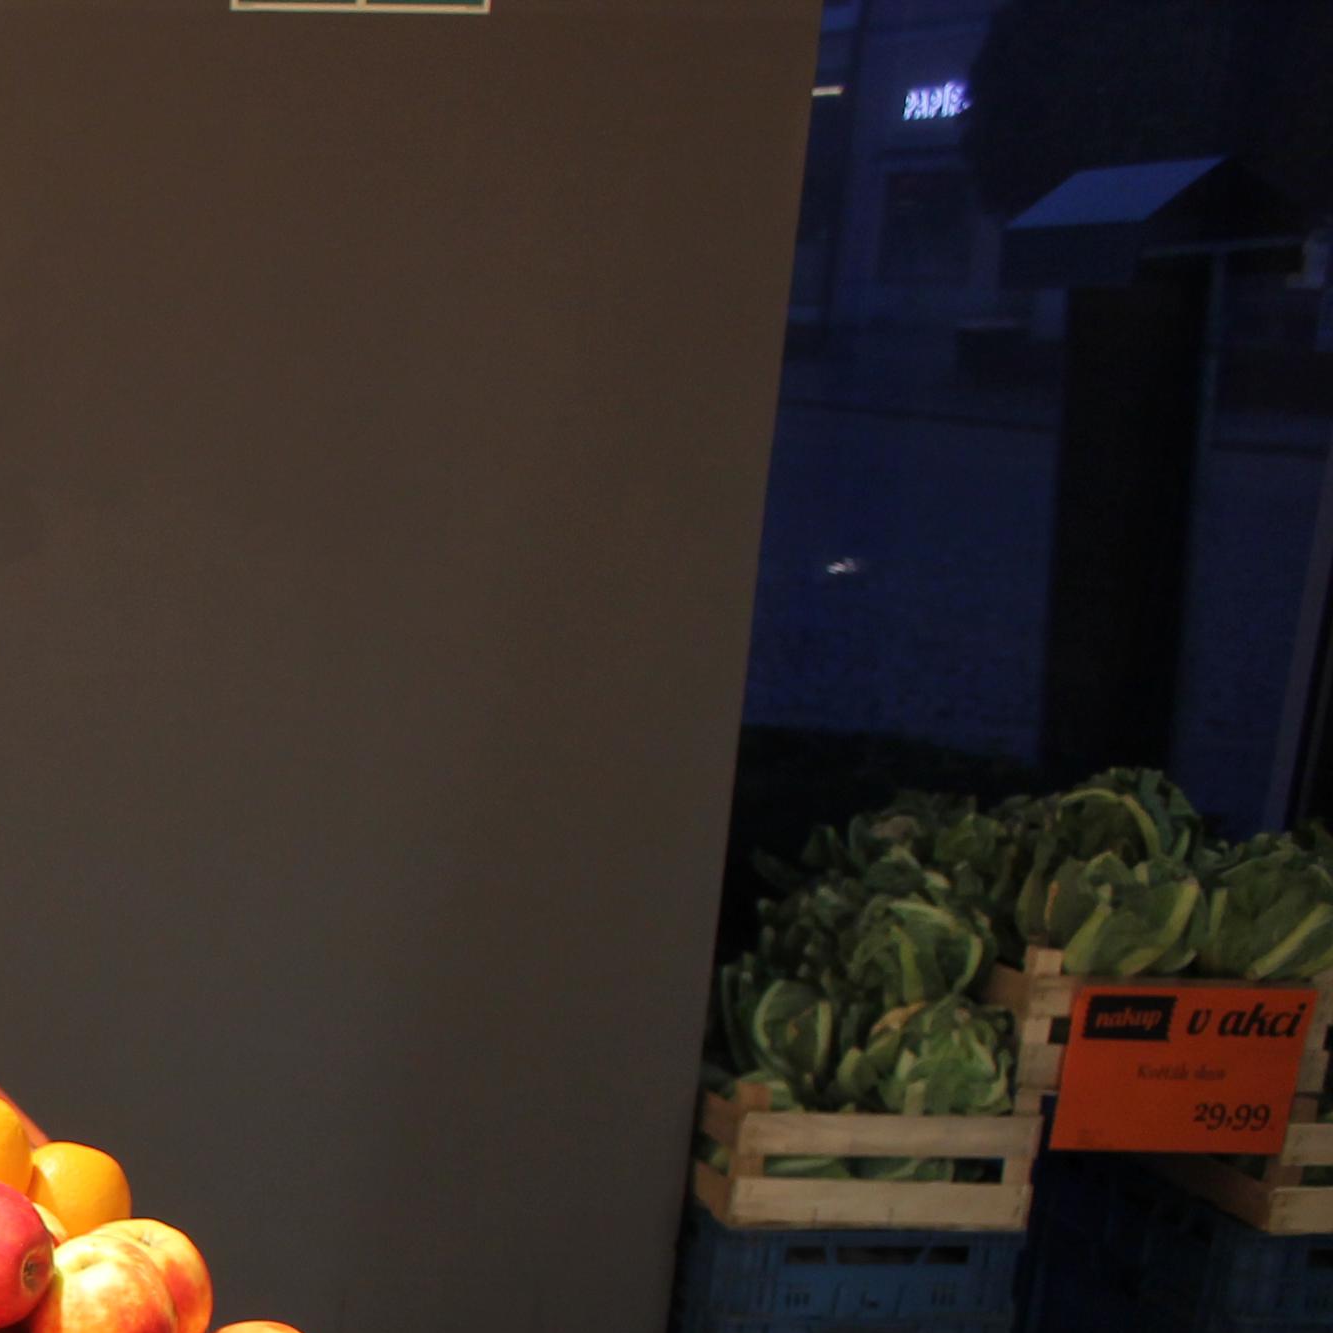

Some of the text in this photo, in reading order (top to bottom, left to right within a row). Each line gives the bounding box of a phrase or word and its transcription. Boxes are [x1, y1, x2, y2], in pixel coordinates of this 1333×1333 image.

[1095, 1005, 1163, 1032] nakup
[1186, 1002, 1308, 1038] v akci
[1193, 1101, 1272, 1132] 29,99
